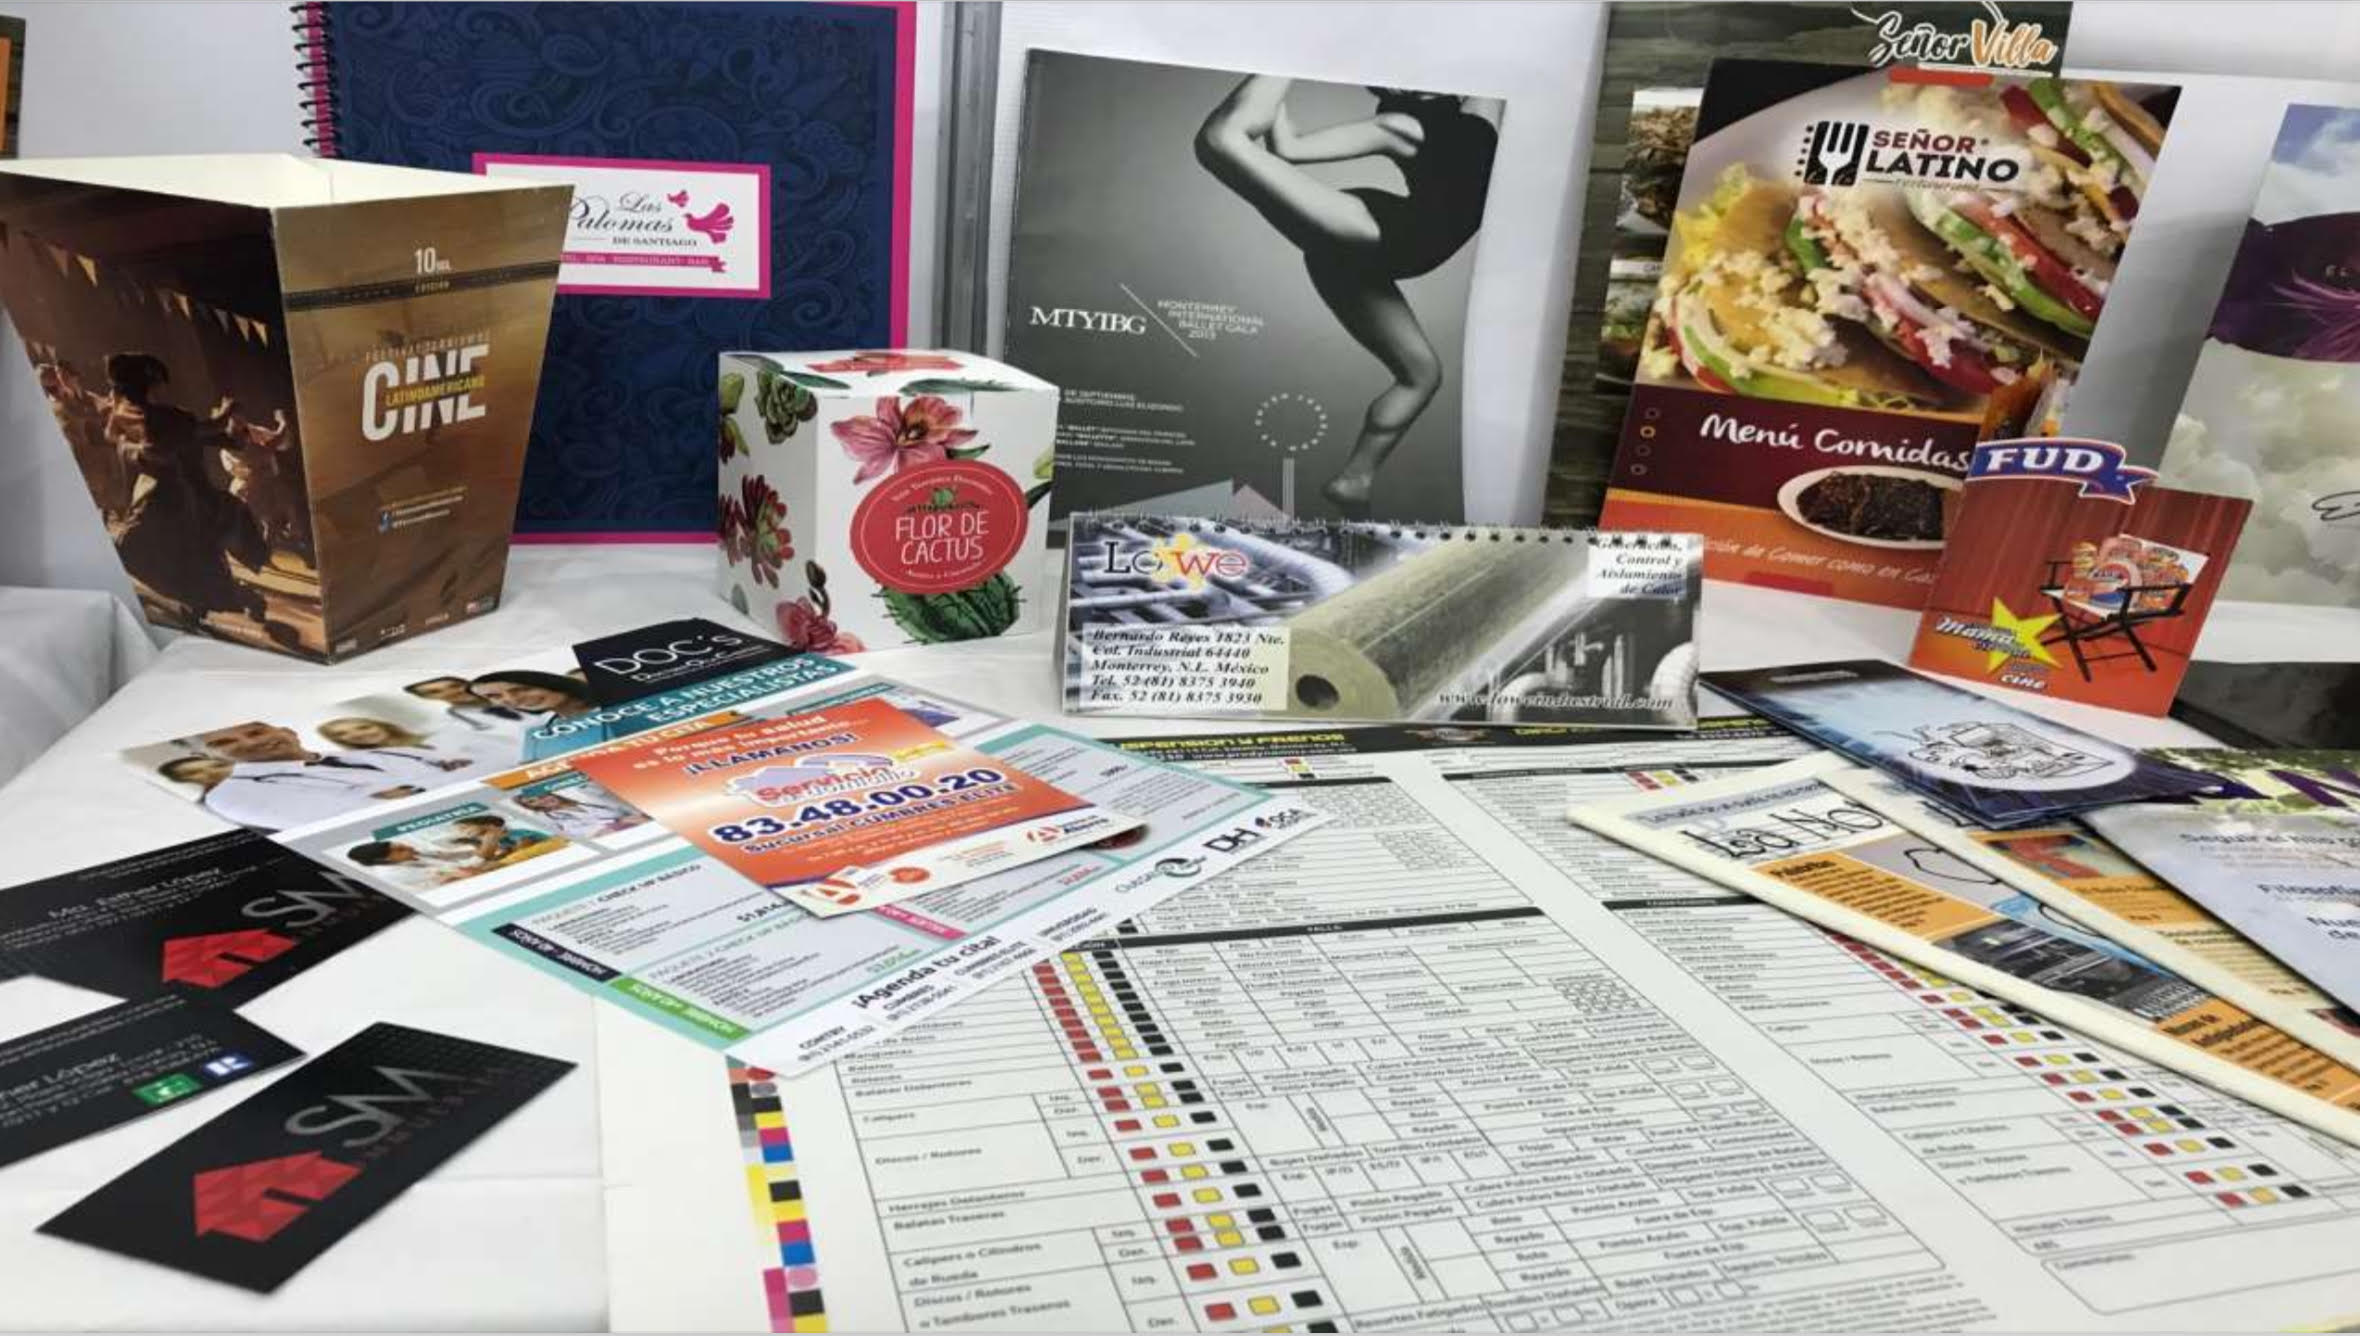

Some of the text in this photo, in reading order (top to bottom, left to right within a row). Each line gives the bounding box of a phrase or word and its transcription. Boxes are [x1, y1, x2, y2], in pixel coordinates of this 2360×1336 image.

[1869, 11, 2059, 68] Señor Villa
[1872, 129, 1976, 154] SEÑOR
[1866, 151, 2020, 184] LATINO
[617, 191, 662, 213] Las
[612, 236, 698, 248] DE SANTIAGO
[1029, 306, 1148, 335] MTYIBG
[361, 343, 490, 442] CINE
[1700, 413, 1972, 472] Menú Comidas
[1986, 446, 2104, 474] FUD
[896, 510, 990, 542] FLOR DE
[900, 536, 984, 565] CACTUS
[1615, 554, 1683, 568] Control y
[1596, 567, 1683, 581] Aislamiento
[1620, 584, 1638, 594] de
[1091, 644, 1250, 658] Col. Industrial 64440
[1092, 628, 1287, 646] Bernardo Reyes 1823 Nte.
[647, 664, 838, 723] ESPECIALISTAS
[1090, 675, 1117, 687] Tel.
[1179, 675, 1214, 689] 8375
[1090, 689, 1123, 702] Fax.
[533, 702, 654, 741] CONOCE
[661, 693, 678, 707] A
[682, 657, 816, 701] NUESTROS
[711, 768, 1004, 844] 83.48.00.20
[744, 821, 846, 852] Sucursal
[849, 797, 953, 829] CUMBRES
[935, 951, 961, 968] tu
